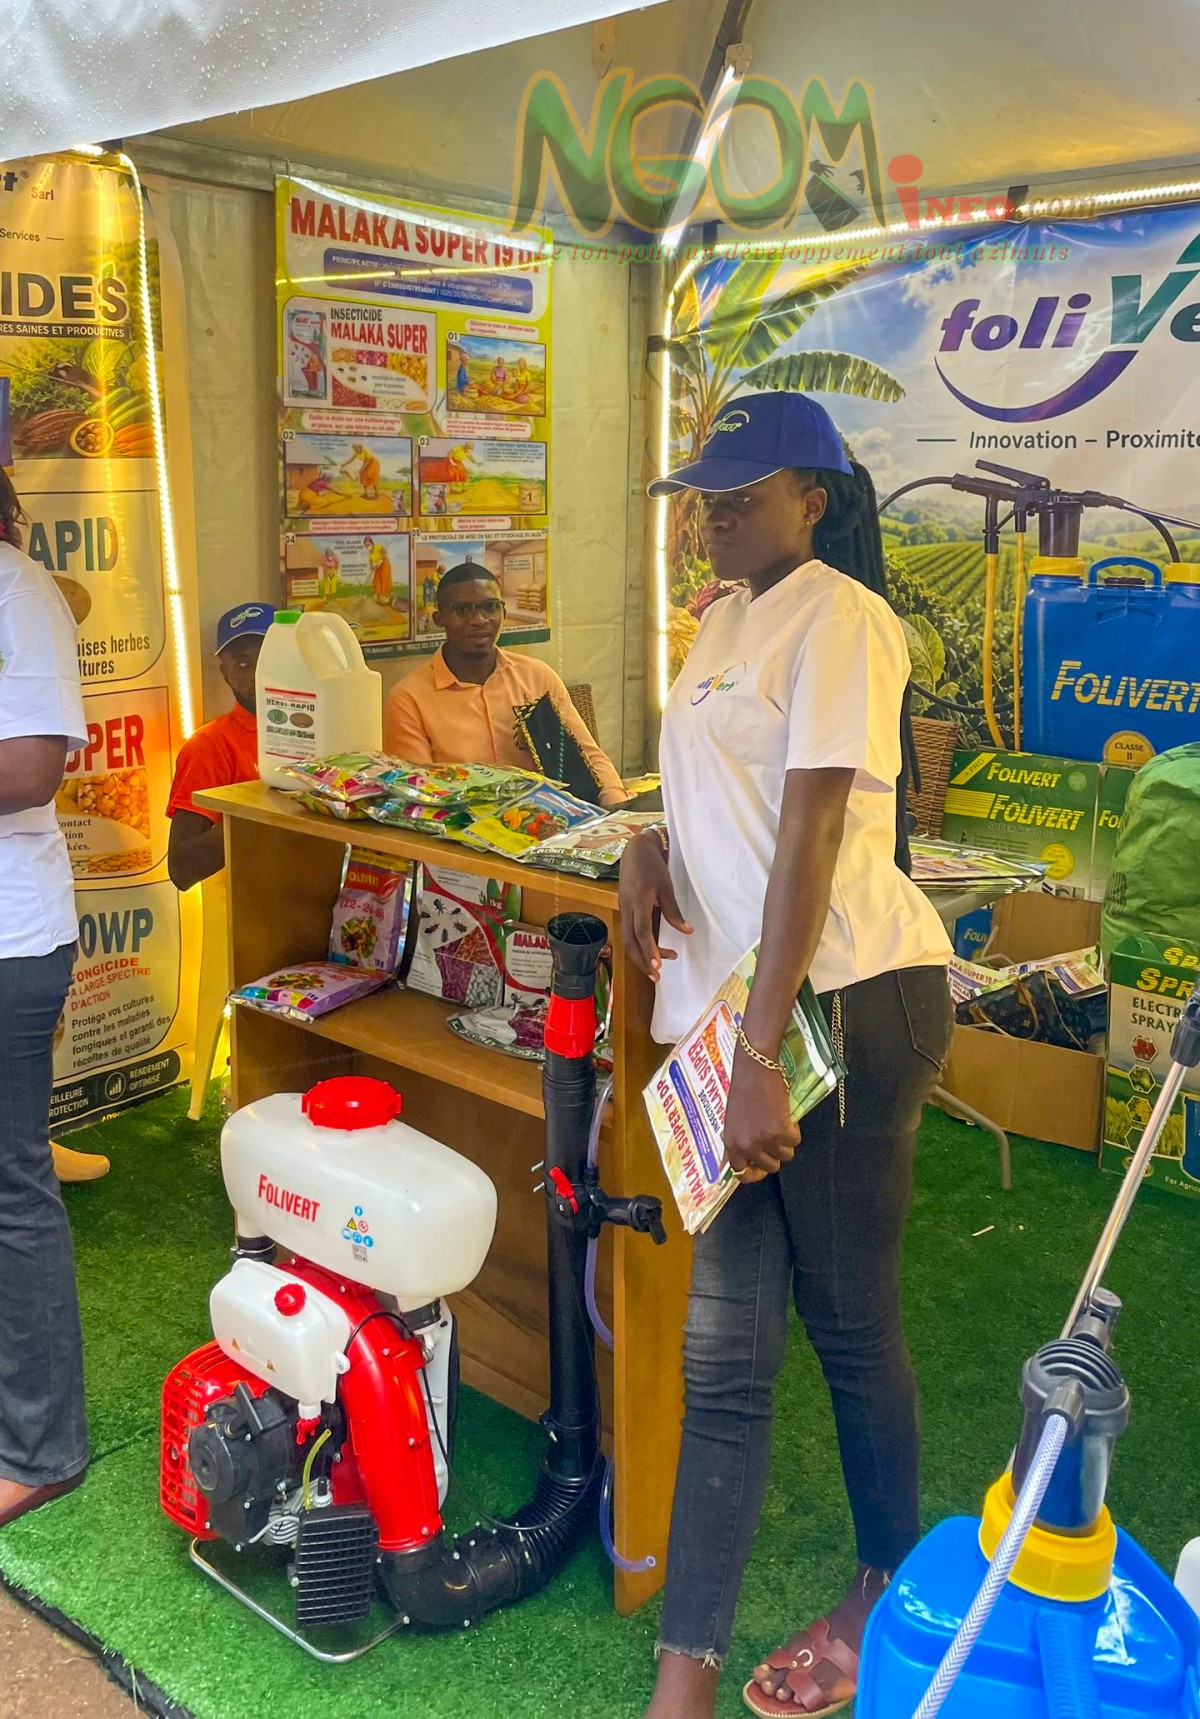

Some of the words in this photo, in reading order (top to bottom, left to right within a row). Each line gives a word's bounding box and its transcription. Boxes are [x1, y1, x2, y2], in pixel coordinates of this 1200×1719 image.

[31, 187, 54, 201] Sarl
[291, 197, 409, 252] MALAKA
[415, 222, 488, 265] SUPER
[331, 308, 382, 322] INSECTICIDE
[17, 323, 50, 335] SAINES
[52, 326, 63, 335] ET
[67, 327, 125, 338] PRODUCTIVES
[331, 322, 384, 346] MALAKA
[387, 323, 428, 354] SUPER
[448, 332, 458, 341] 01
[283, 431, 294, 440] 02
[420, 437, 429, 446] 03
[969, 430, 1077, 449] Innovation
[285, 534, 295, 543] 04
[110, 633, 150, 653] herbes
[1051, 660, 1200, 713] FOLIVERT
[1114, 743, 1144, 752] CLASSE
[1127, 752, 1133, 760] B
[968, 758, 984, 773] PRO
[987, 762, 1061, 788] FOLIVERT
[989, 793, 1085, 831] FOLIVERT
[80, 980, 105, 995] LARGE
[107, 967, 151, 984] SPECTRE
[71, 991, 111, 1011] D'ACTION
[72, 1011, 106, 1029] Protège
[108, 1006, 121, 1018] vos
[122, 994, 155, 1011] cultures
[72, 1029, 101, 1042] contre
[104, 1022, 116, 1033] les
[117, 1009, 150, 1028] maladies
[1131, 1013, 1175, 1033] SPRAY
[72, 1037, 117, 1056] fongiques
[119, 1031, 127, 1042] et
[129, 1020, 155, 1041] garanti
[156, 1014, 171, 1027] des
[73, 1051, 109, 1068] récoltes
[111, 1045, 122, 1057] de
[125, 1036, 151, 1054] qualité
[688, 1036, 711, 1081] SUPER
[129, 1058, 170, 1079] RENDEMENT
[656, 1079, 670, 1099] DP
[663, 1094, 674, 1113] 19
[698, 1089, 721, 1133] INSECTICIDE
[668, 1107, 688, 1151] SUPER
[681, 1145, 706, 1208] MALAKA
[1165, 1176, 1177, 1185] For
[258, 1174, 320, 1223] FOLIVERT
